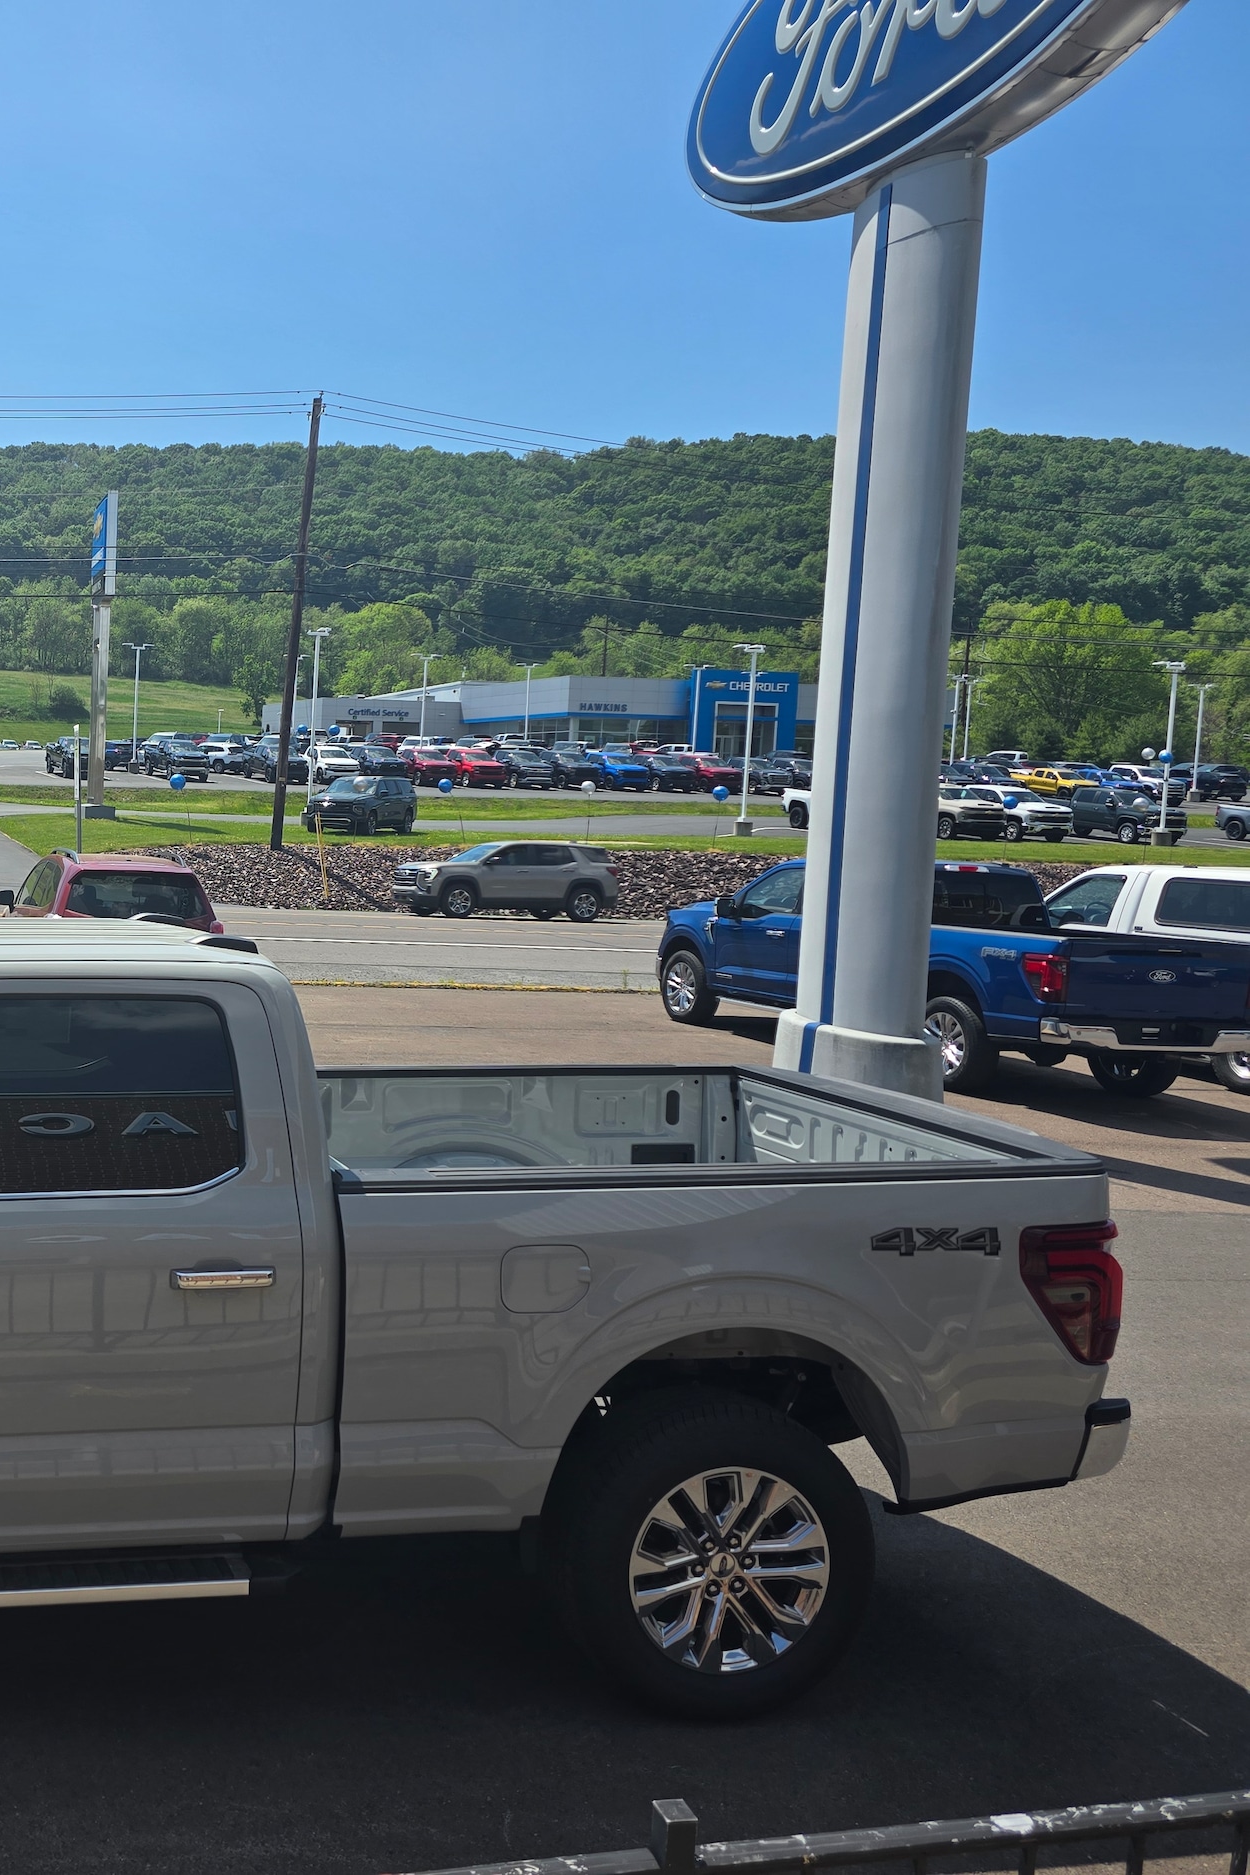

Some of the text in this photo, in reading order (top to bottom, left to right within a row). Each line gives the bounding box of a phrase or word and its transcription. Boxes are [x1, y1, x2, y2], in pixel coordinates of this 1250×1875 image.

[729, 681, 790, 693] CHEROLET
[348, 708, 409, 717] Certified Service
[580, 702, 628, 713] HAWKINS
[981, 946, 1017, 959] FX4
[1152, 971, 1172, 981] Ford
